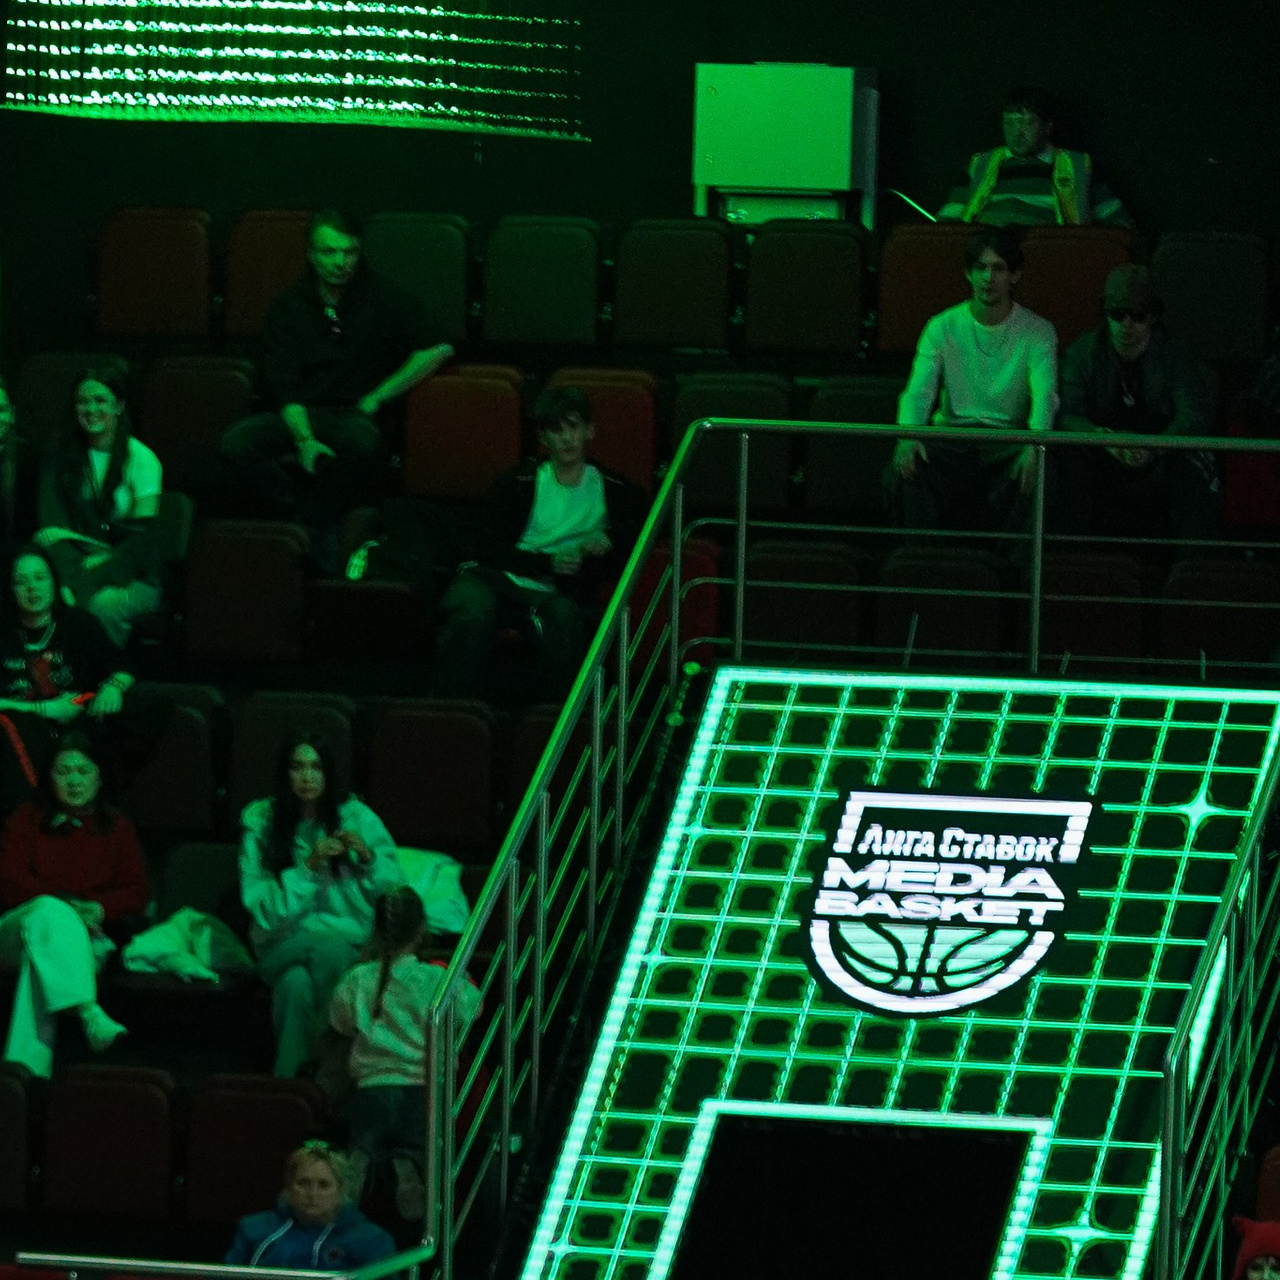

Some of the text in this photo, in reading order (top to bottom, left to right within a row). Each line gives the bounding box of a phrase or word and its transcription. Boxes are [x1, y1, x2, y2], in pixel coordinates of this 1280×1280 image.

[939, 827, 1060, 864] СТАВОК
[820, 857, 1065, 900] MEDIA
[814, 889, 1065, 926] BASKET
